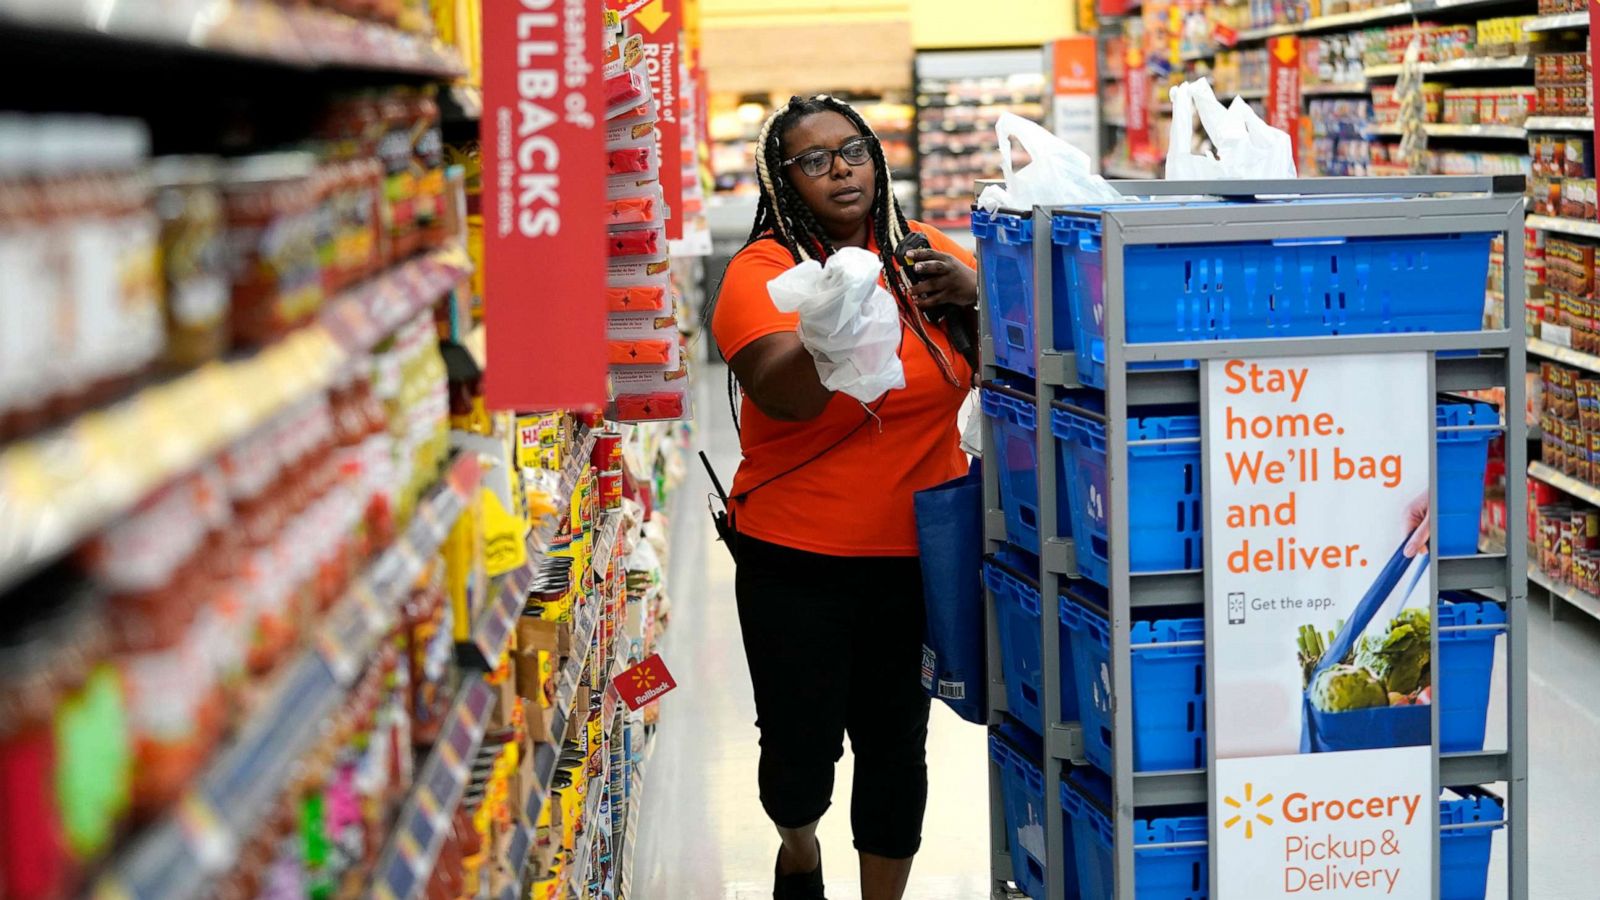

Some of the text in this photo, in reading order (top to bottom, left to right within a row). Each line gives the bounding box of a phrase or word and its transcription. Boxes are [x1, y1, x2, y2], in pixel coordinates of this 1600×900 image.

[662, 42, 676, 123] Thousands of
[517, 0, 561, 238] LLBACKS
[564, 92, 595, 128] of
[1224, 359, 1309, 402] Stay
[1225, 406, 1345, 440] home.
[1225, 446, 1402, 488] We'll bag
[1226, 491, 1296, 528] and
[1226, 537, 1368, 574] deliver.
[1251, 597, 1335, 611] Get the app.
[635, 681, 670, 705] Rollback
[1282, 792, 1421, 825] Grocery
[1285, 834, 1376, 865] Pickup
[1285, 864, 1400, 894] Delivery
